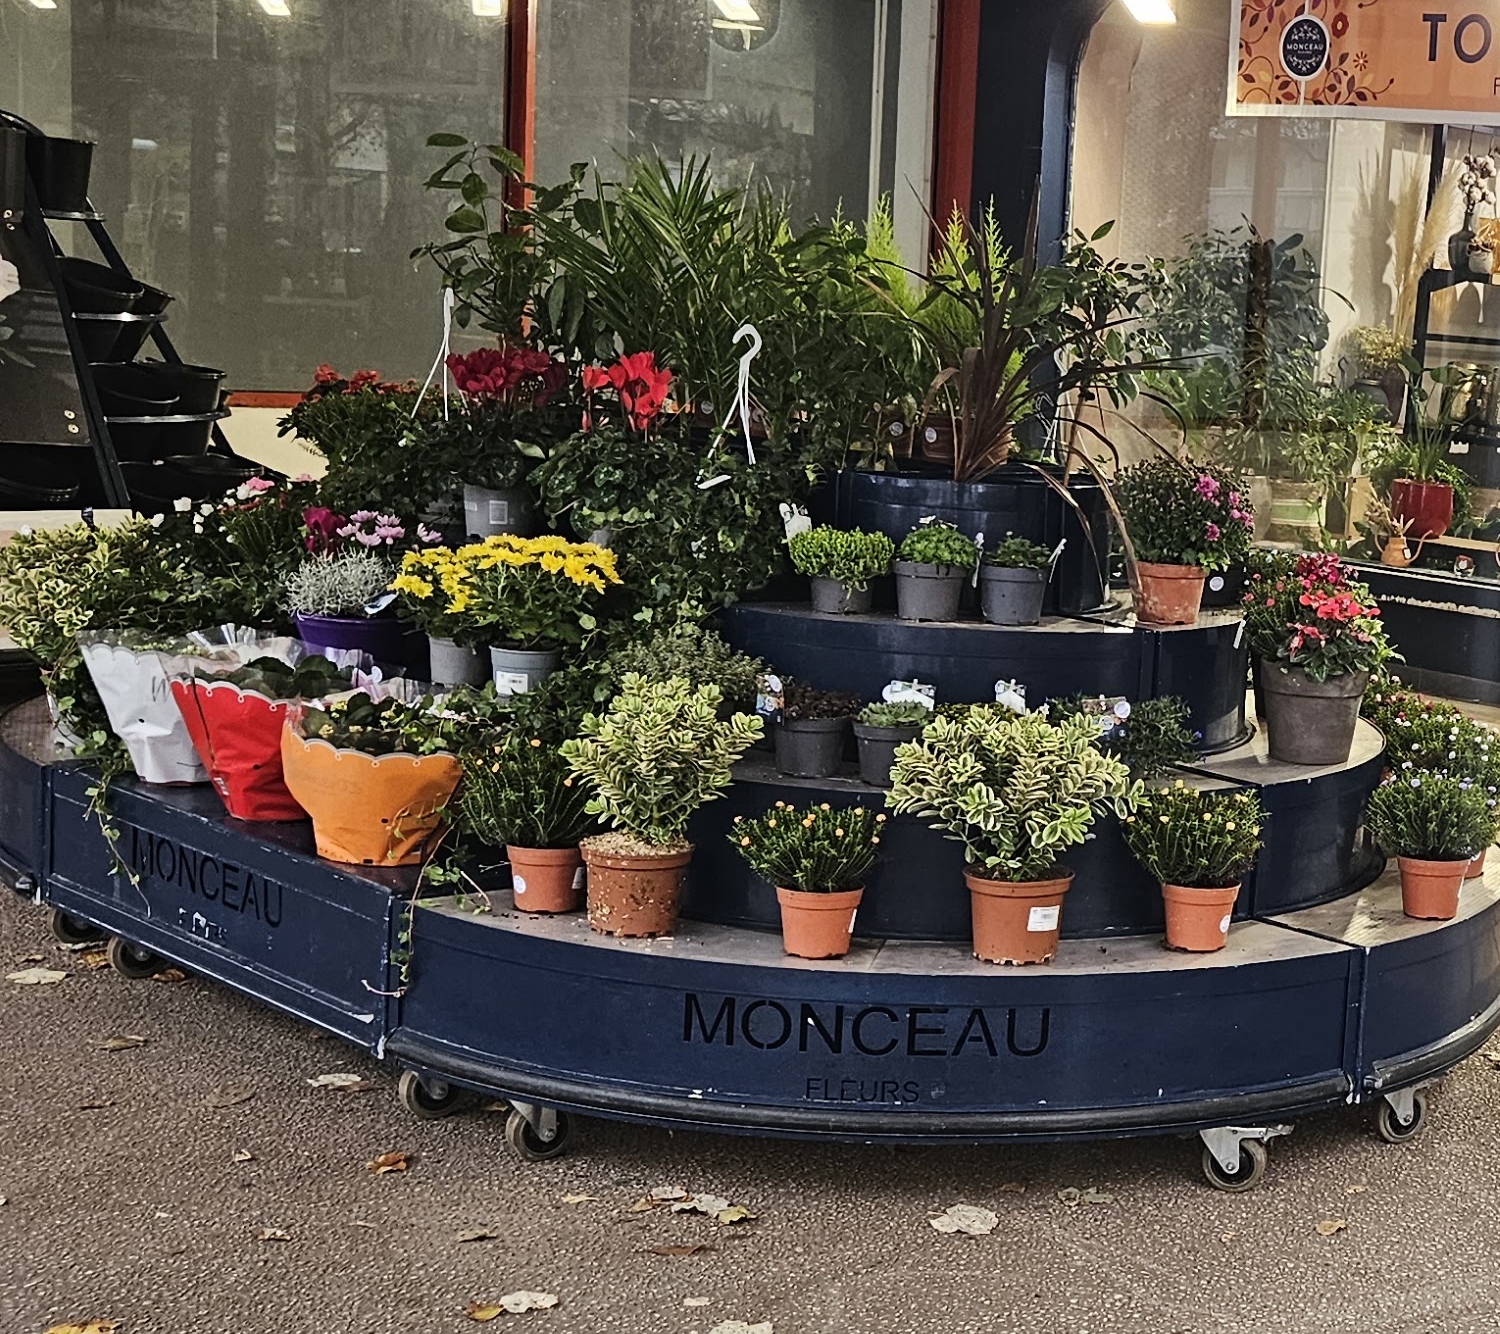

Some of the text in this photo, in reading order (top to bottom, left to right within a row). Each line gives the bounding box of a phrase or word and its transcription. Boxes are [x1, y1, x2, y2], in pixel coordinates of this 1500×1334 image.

[1286, 43, 1324, 51] MONCEAU
[130, 825, 283, 929] MONCEAU
[681, 992, 1052, 1058] MONCEAU
[804, 1077, 921, 1104] FLEURS
